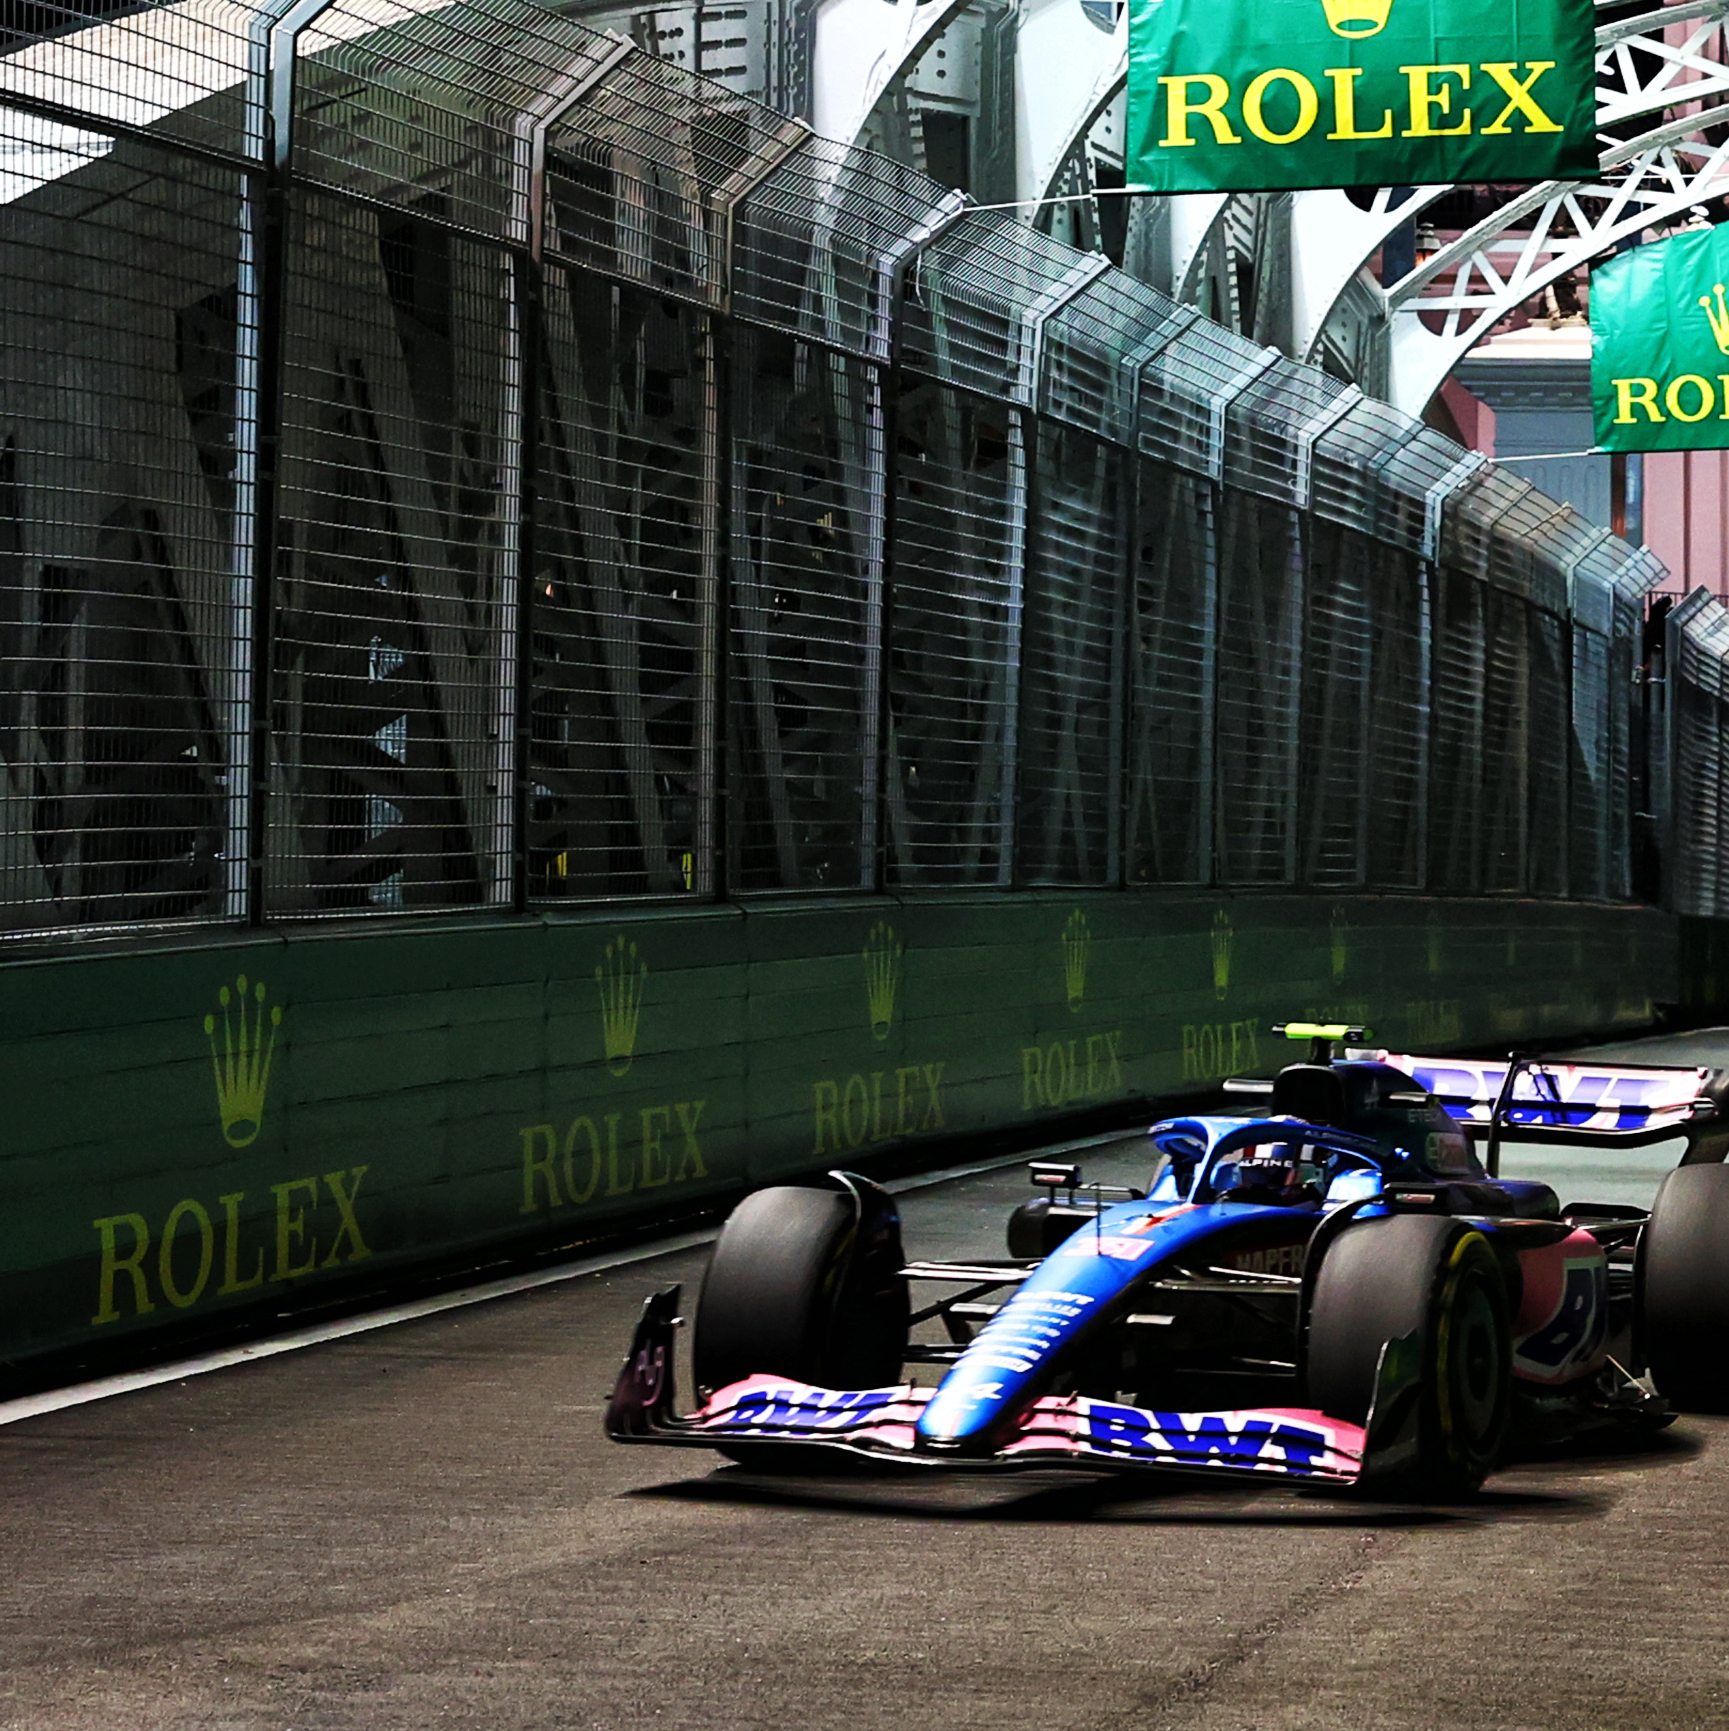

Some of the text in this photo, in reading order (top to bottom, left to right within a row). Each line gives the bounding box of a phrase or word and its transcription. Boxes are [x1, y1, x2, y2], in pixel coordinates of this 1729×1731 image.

[1158, 60, 1564, 147] ROLEX
[812, 1062, 946, 1156] ROLEX
[1020, 1030, 1124, 1111] ROLEX
[518, 1100, 710, 1214] ROLEX
[91, 1165, 372, 1326] ROLEX
[1088, 1403, 1327, 1476] BWT
